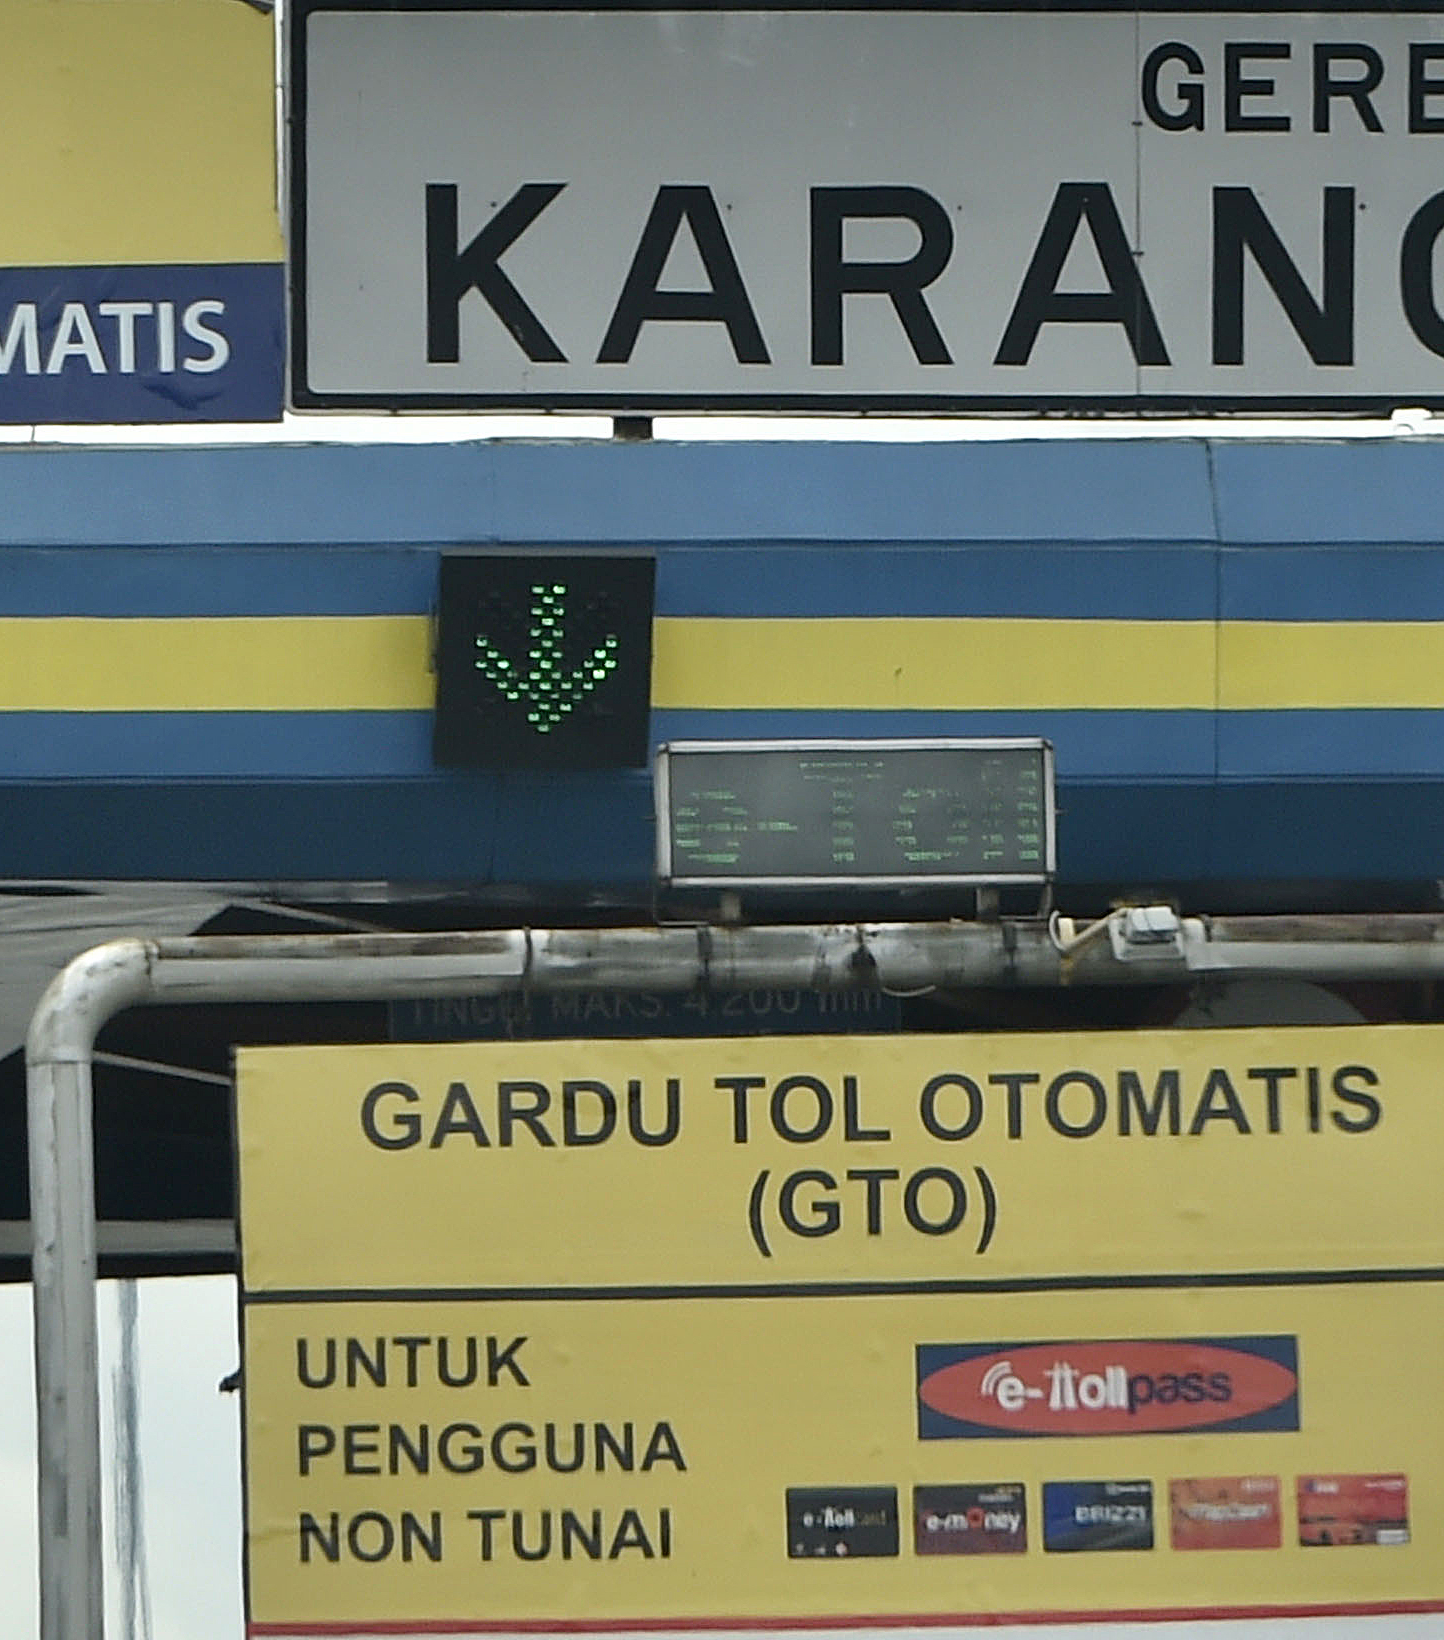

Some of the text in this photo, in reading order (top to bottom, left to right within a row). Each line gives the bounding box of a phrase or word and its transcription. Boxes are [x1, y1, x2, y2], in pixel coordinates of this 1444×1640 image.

[360, 1065, 1382, 1151] GARDU TOL OTOMATIS
[748, 1166, 997, 1258] (GTO)
[296, 1335, 531, 1390] UNTUK
[298, 1421, 688, 1477] PENGGUNA
[299, 1508, 671, 1564] NON TUNAI
